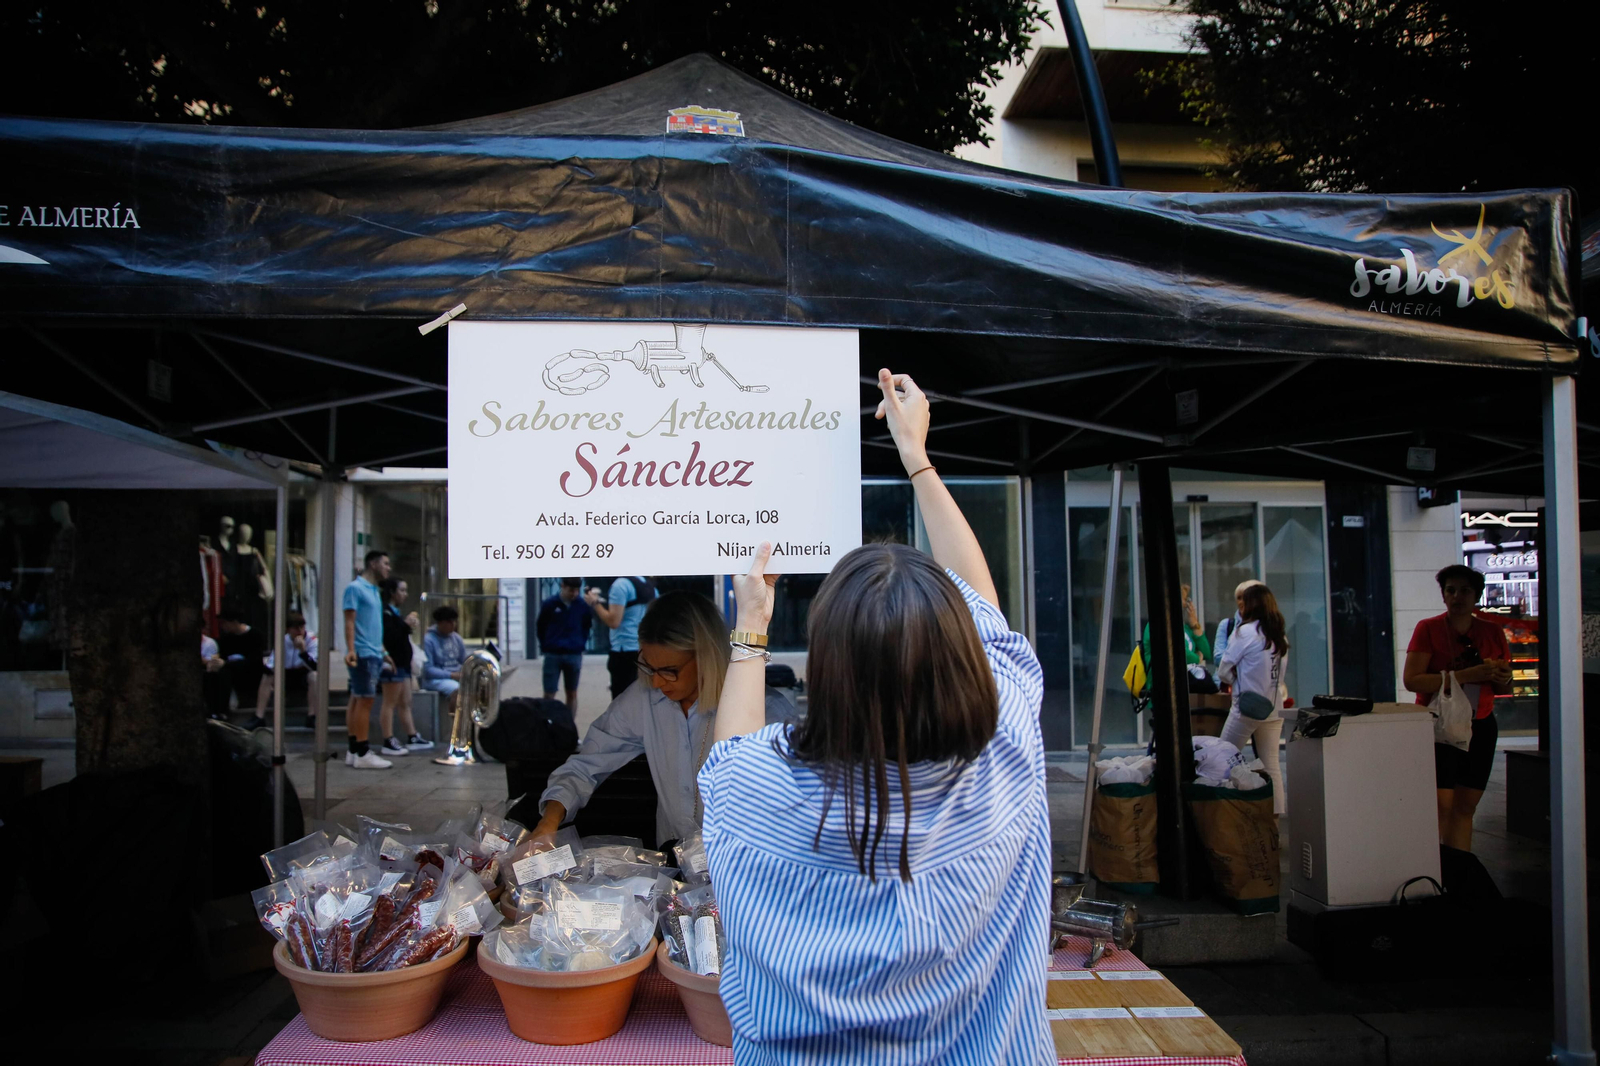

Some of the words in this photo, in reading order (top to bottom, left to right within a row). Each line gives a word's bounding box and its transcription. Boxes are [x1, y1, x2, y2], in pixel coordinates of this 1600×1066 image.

[17, 202, 141, 229] ALMERÍA
[1350, 248, 1516, 309] sabores
[1368, 300, 1442, 317] ALMERÍA
[467, 400, 624, 438] Sabores
[625, 397, 842, 439] Artesanales
[559, 440, 755, 498] Sánchez
[535, 510, 579, 527] Avda.
[585, 510, 647, 526] Federico
[652, 509, 700, 525] García
[706, 510, 751, 525] Lorca,
[755, 509, 779, 524] 108
[481, 544, 510, 560] Tel.
[515, 544, 546, 560] 950
[550, 544, 565, 560] 61
[570, 544, 591, 559] 22
[595, 543, 615, 559] 89
[716, 542, 755, 560] Níjar
[771, 541, 831, 556] Almería
